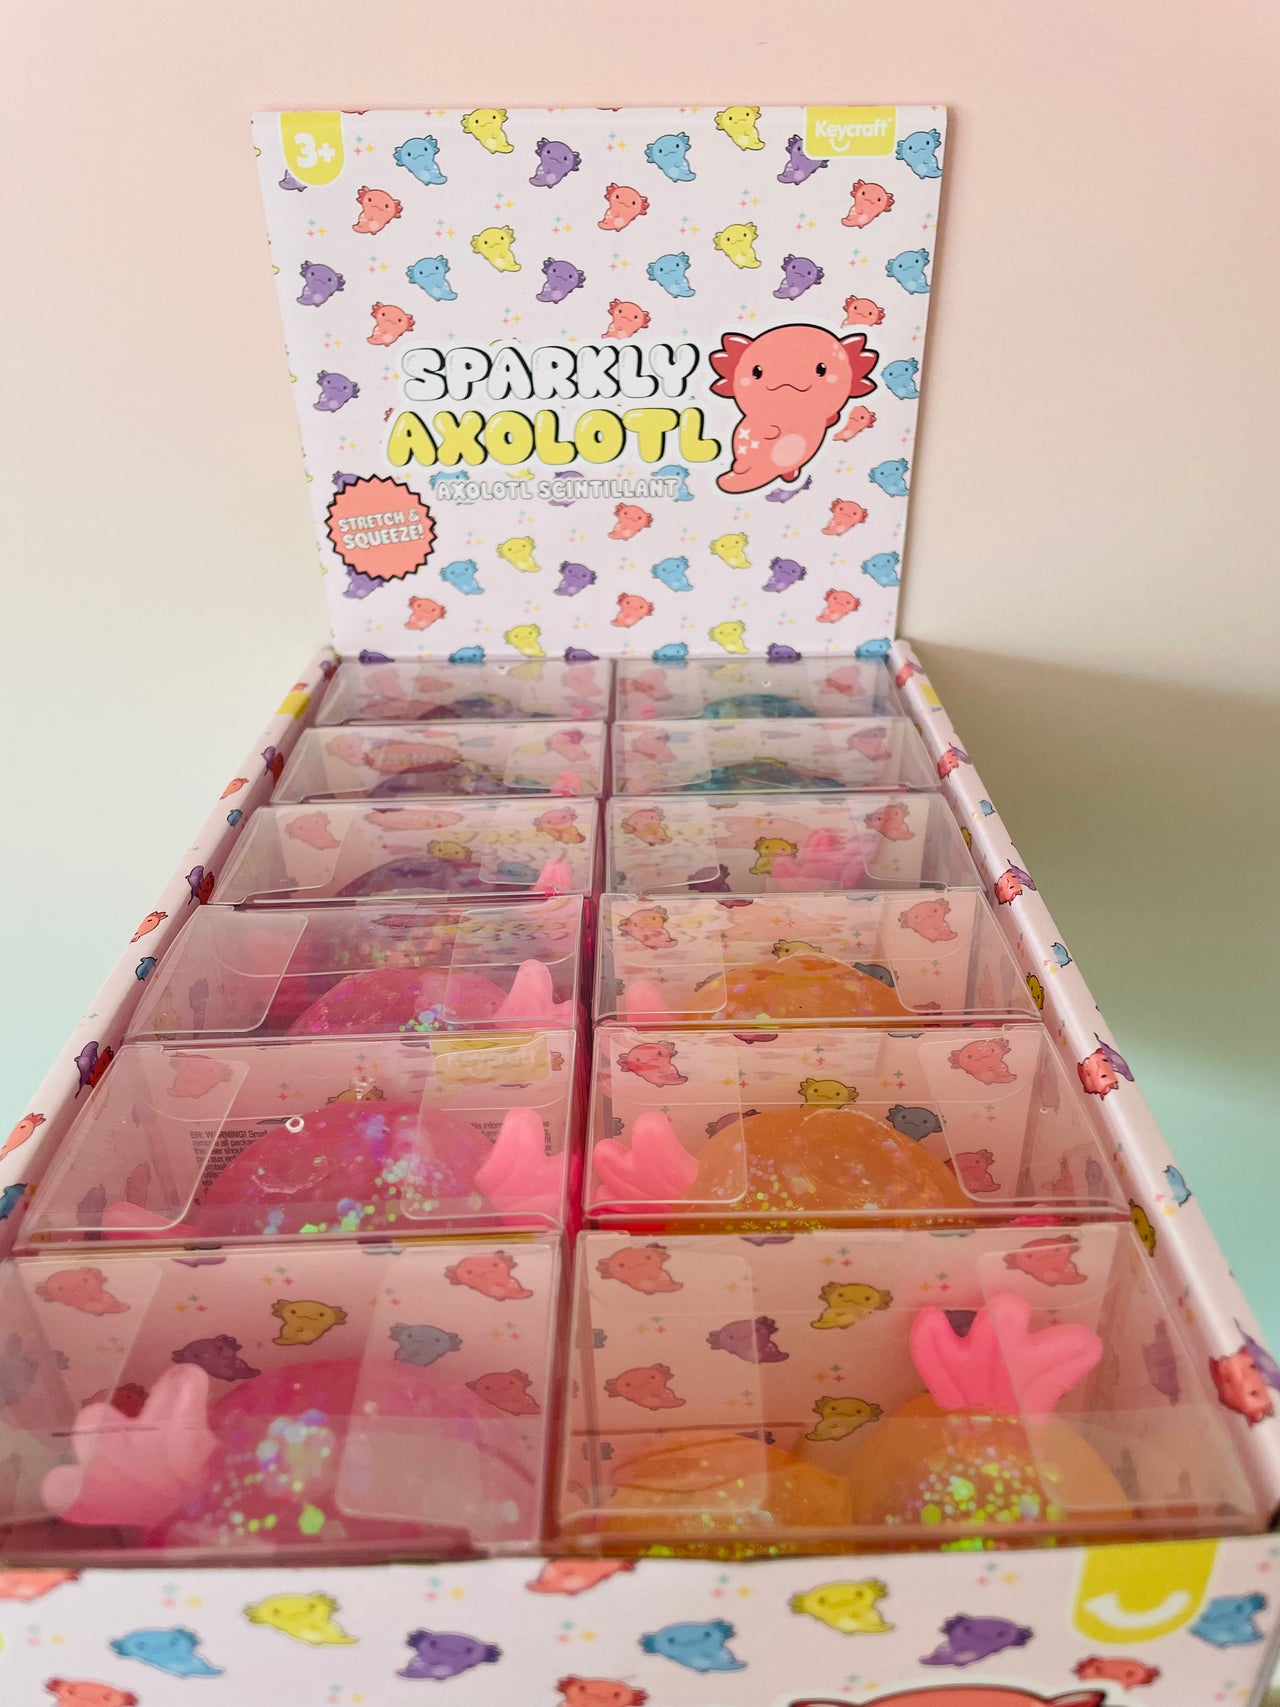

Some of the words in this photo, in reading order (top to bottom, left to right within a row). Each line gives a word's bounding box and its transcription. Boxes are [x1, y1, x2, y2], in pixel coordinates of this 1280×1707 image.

[815, 118, 888, 143] Keycraft
[293, 132, 336, 168] 3+
[401, 343, 700, 401] SPARKLY
[387, 407, 722, 467] AXOLOTL
[436, 480, 533, 501] AXOLOTL
[537, 478, 678, 499] SCINTILLANT
[338, 511, 405, 533] STRETCH
[408, 508, 419, 522] &
[342, 524, 425, 550] SQUEEZE!
